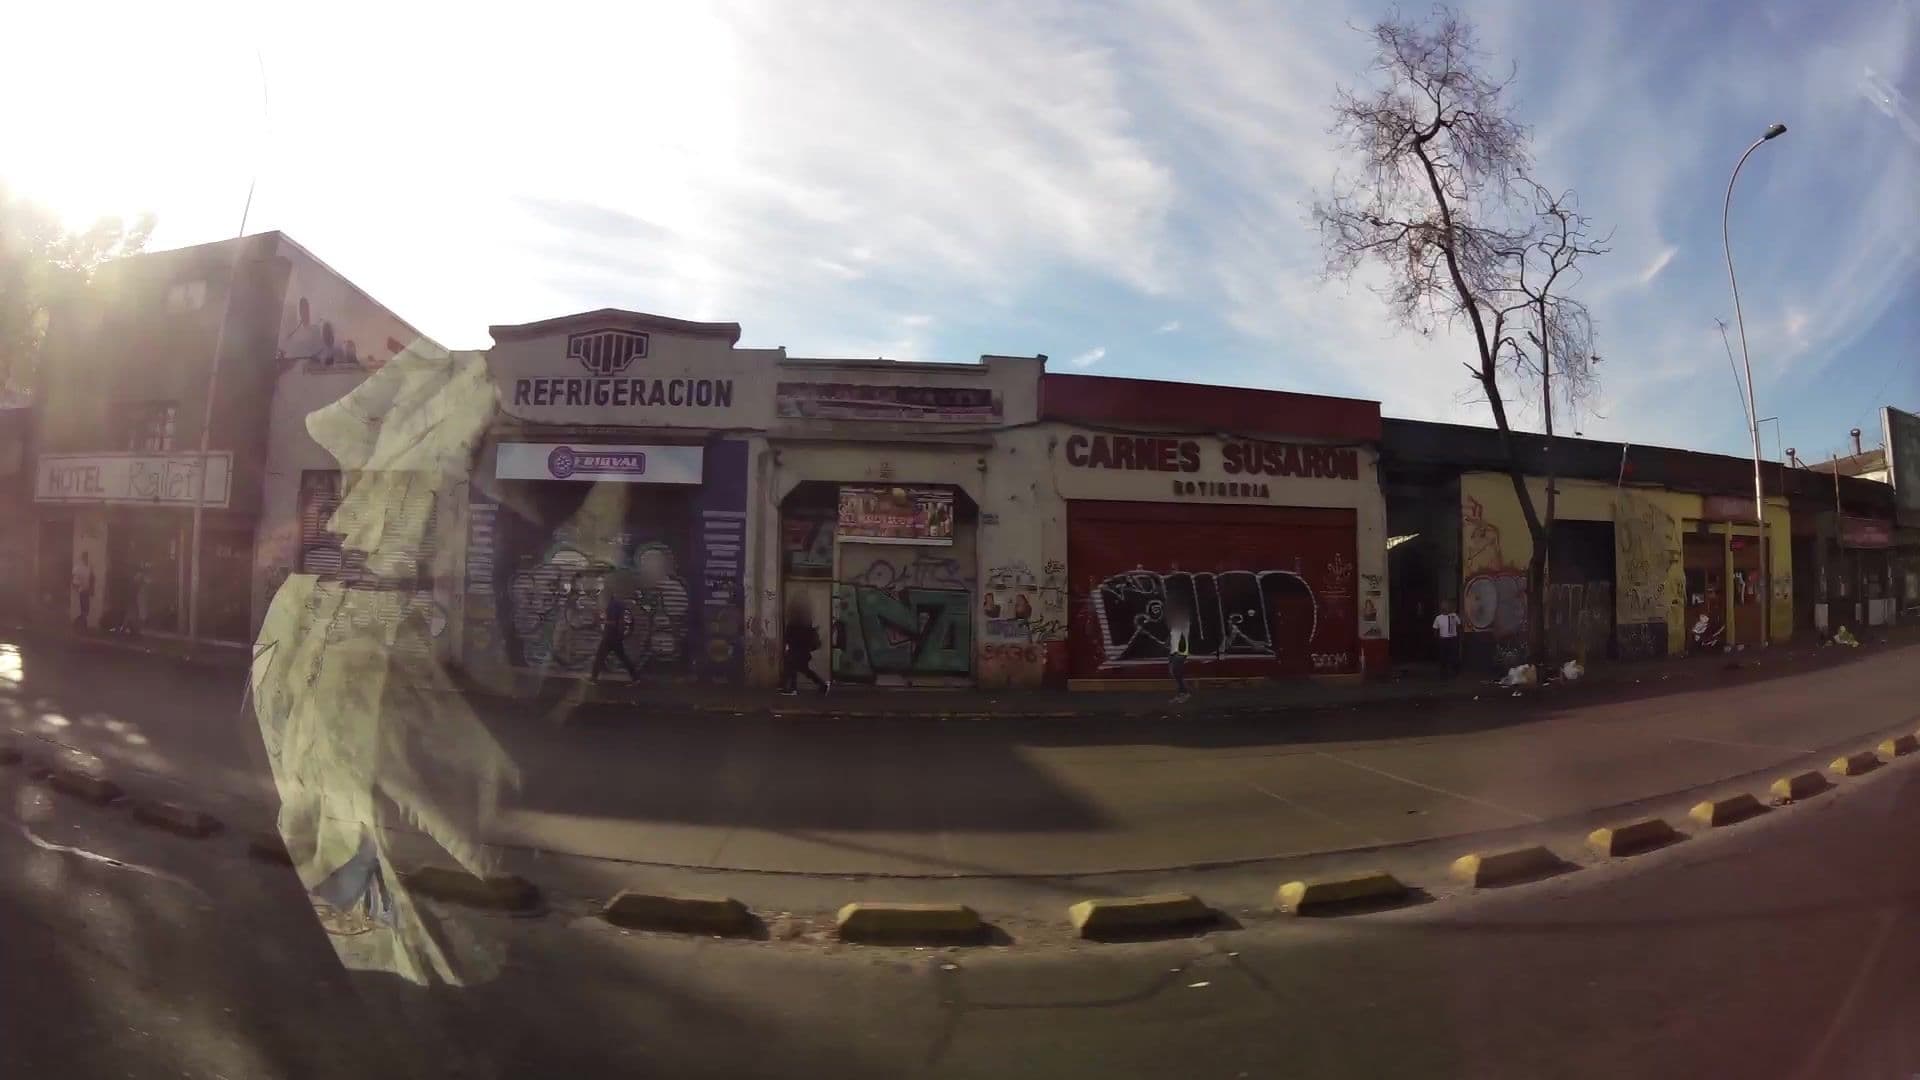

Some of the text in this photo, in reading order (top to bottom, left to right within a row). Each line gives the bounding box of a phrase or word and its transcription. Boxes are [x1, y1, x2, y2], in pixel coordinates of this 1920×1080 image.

[514, 378, 734, 408] REFRIGERACION
[1065, 435, 1359, 481] CARNES SUSARON
[48, 464, 105, 494] HOTEL
